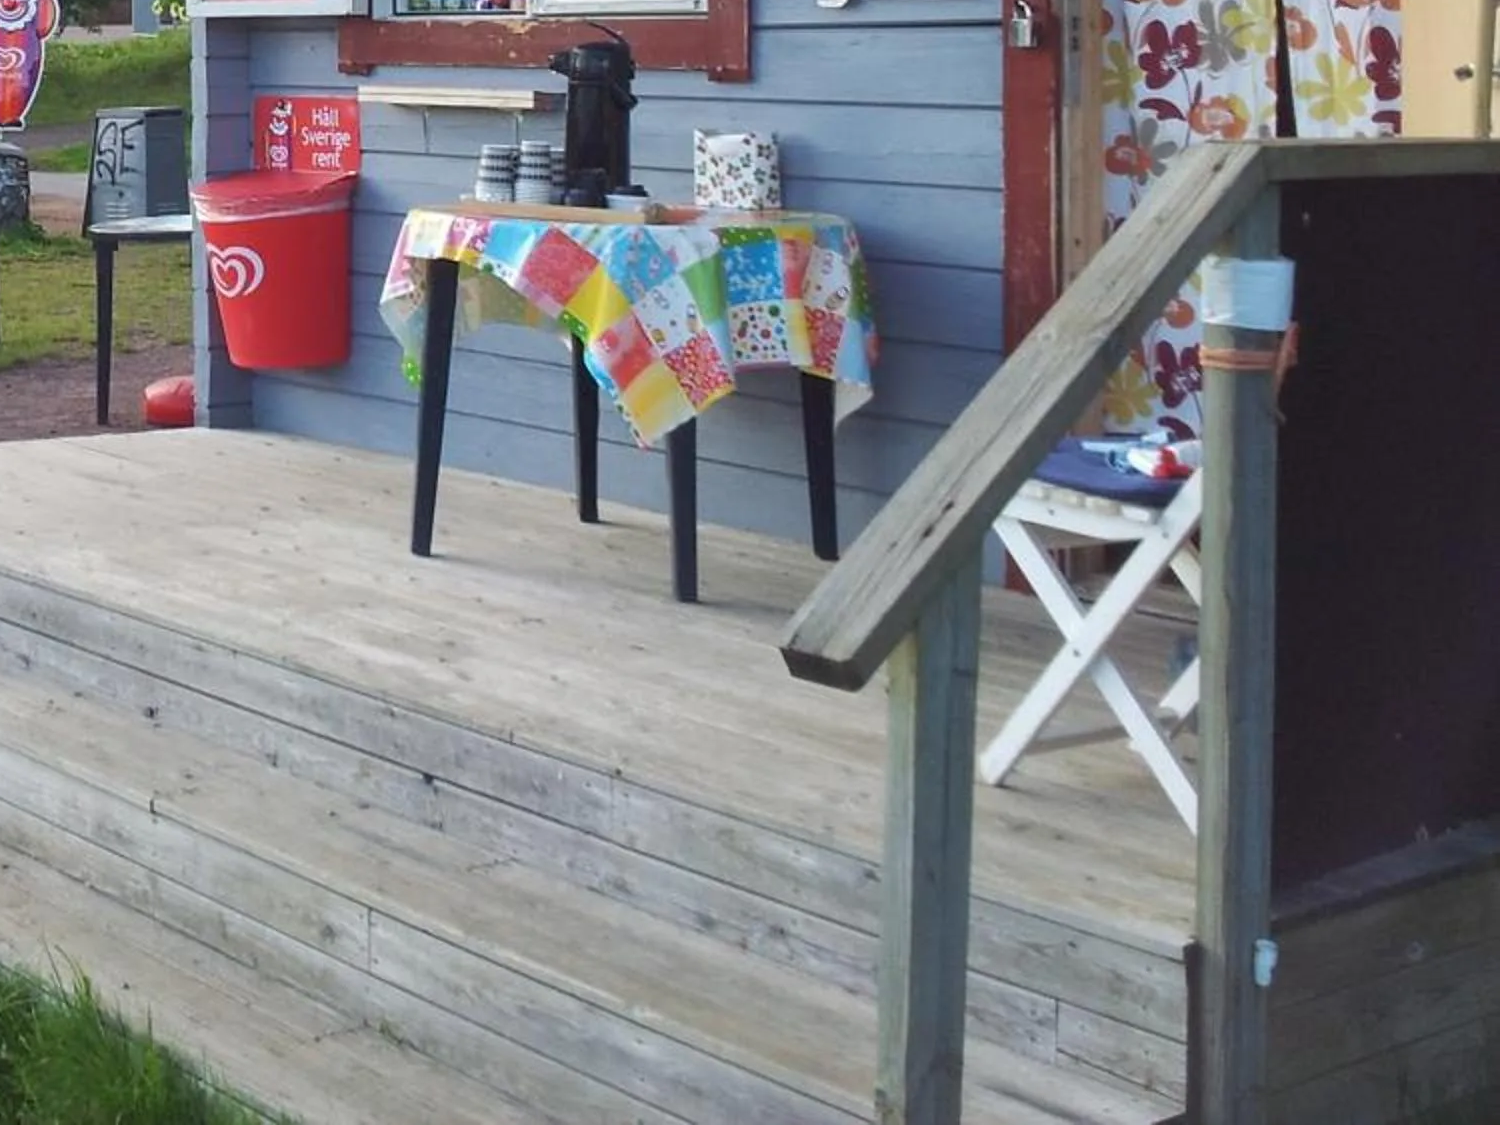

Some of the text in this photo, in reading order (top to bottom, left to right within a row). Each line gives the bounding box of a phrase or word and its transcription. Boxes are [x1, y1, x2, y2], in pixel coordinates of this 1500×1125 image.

[311, 106, 339, 127] Håll
[301, 126, 352, 152] Sverige
[311, 149, 342, 168] rent
